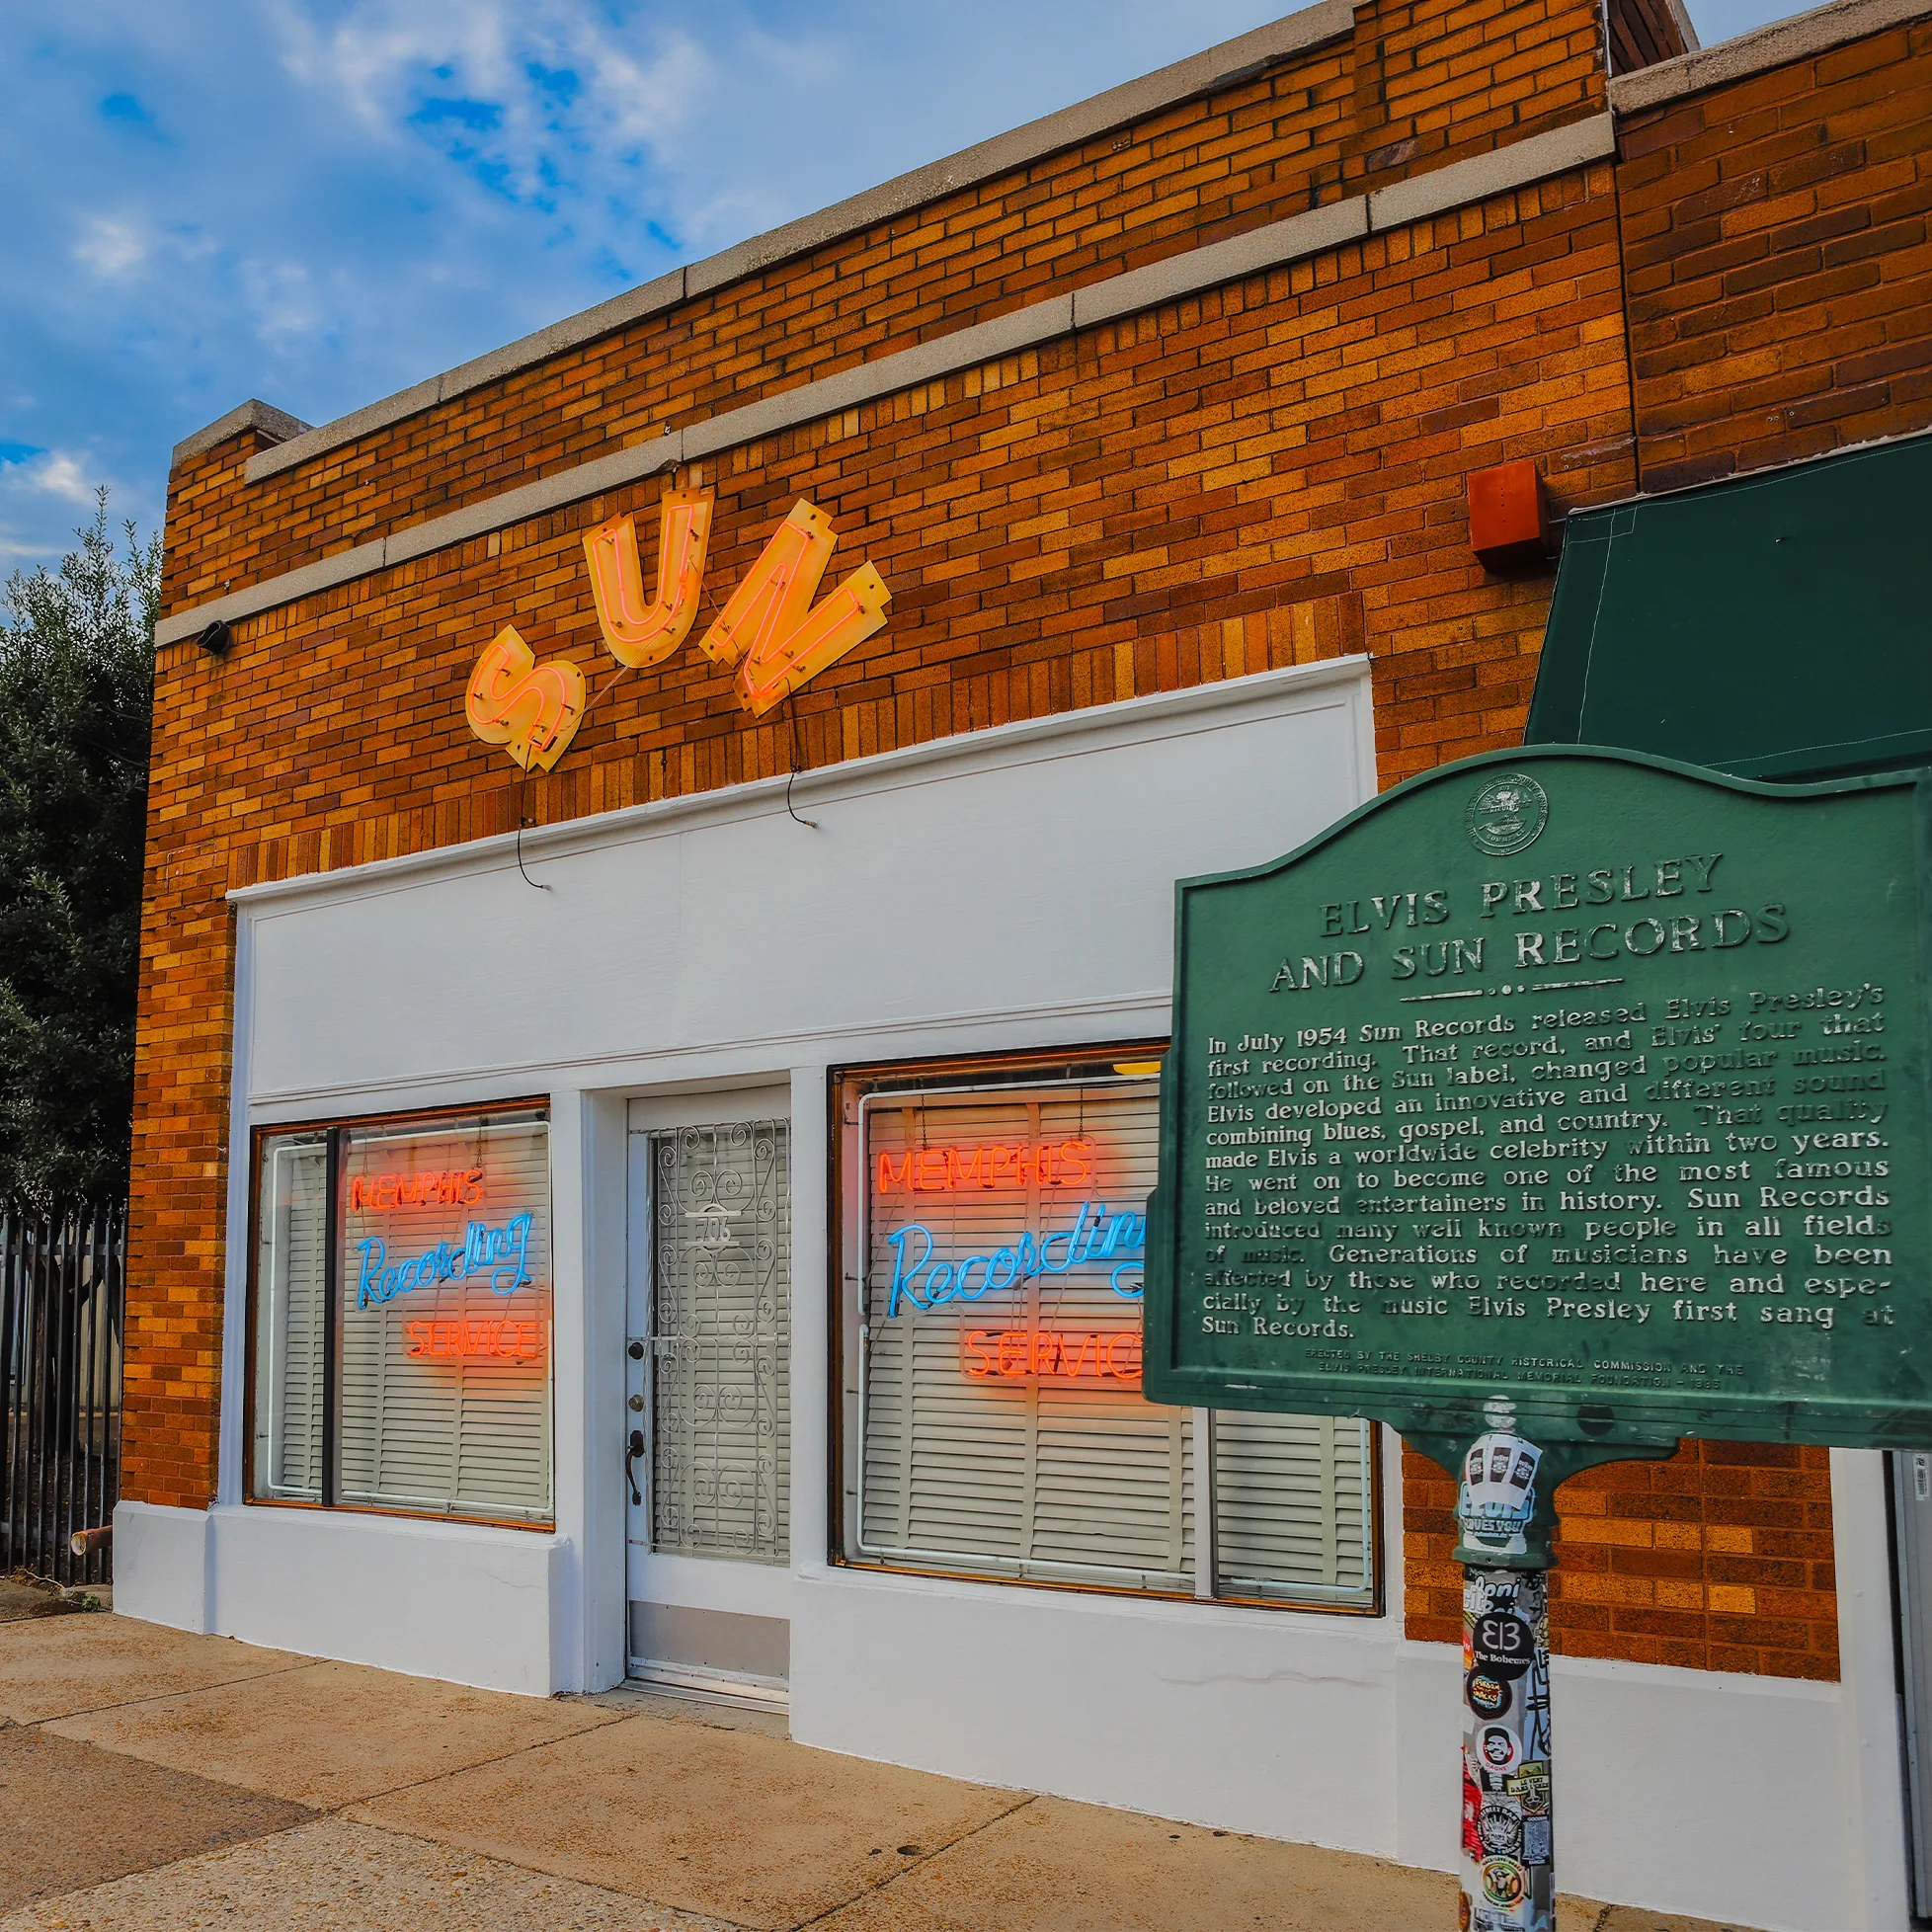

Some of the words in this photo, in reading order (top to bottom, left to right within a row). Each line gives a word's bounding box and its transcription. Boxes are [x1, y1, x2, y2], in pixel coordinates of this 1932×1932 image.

[465, 488, 892, 772] SUN
[1319, 889, 1450, 937] ELVIS
[1479, 852, 1724, 919] PRESLEY
[1269, 951, 1365, 993] AND
[1391, 936, 1486, 981] SUN
[1514, 903, 1791, 970] RECORDS
[1208, 1037, 1227, 1054] In
[1238, 1033, 1284, 1053] July
[1297, 1027, 1347, 1047] 1954
[1359, 1024, 1402, 1042] Sun
[1415, 1014, 1514, 1038] Records
[1531, 1002, 1648, 1030] released
[1664, 997, 1731, 1020] Elvis
[1748, 983, 1884, 1013] Presley's
[1208, 1059, 1249, 1077] first
[1261, 1053, 1378, 1074] recording.
[1403, 1044, 1458, 1064] That
[1472, 1035, 1567, 1060] record,
[1585, 1030, 1632, 1053] and
[1739, 1020, 1802, 1042] four
[1820, 1011, 1884, 1036] that
[1208, 1078, 1293, 1100] followed
[1303, 1079, 1329, 1094] on
[1343, 1074, 1381, 1091] the
[1392, 1070, 1434, 1087] Sun
[1446, 1064, 1515, 1085] label,
[1531, 1056, 1648, 1082] changed
[1663, 1049, 1777, 1077] popular
[1794, 1040, 1887, 1065] music.
[1208, 1105, 1254, 1123] Elvis
[1265, 1097, 1381, 1119] developed
[1395, 1100, 1422, 1114] an
[1435, 1088, 1566, 1112] innovative
[1578, 1084, 1628, 1104] and
[1643, 1079, 1776, 1100] different
[1794, 1069, 1887, 1093] sound
[1206, 1126, 1312, 1148] combining
[1324, 1123, 1386, 1142] blues,
[1399, 1117, 1485, 1143] gospel,
[1499, 1114, 1544, 1133] and
[1558, 1109, 1668, 1132] country.
[1695, 1103, 1762, 1126] That
[1777, 1098, 1889, 1126] quality
[879, 1141, 1088, 1193] MEMPHIS
[1205, 1152, 1257, 1168] made
[1267, 1149, 1318, 1167] Elvis
[1328, 1152, 1341, 1166] a
[1354, 1143, 1478, 1165] worldwide
[1489, 1137, 1608, 1161] celebrity
[1628, 1132, 1711, 1155] within
[1726, 1133, 1778, 1152] two
[1791, 1130, 1890, 1155] years.
[352, 1168, 483, 1211] MEMPHIS
[1205, 1175, 1232, 1192] He
[1248, 1173, 1297, 1191] went
[1314, 1174, 1341, 1190] on
[1357, 1171, 1380, 1188] to
[1394, 1169, 1485, 1187] become
[1502, 1168, 1549, 1186] one
[1567, 1164, 1594, 1183] of
[1613, 1164, 1657, 1182] the
[1679, 1160, 1751, 1181] most
[1774, 1158, 1890, 1179] famous
[1205, 1198, 1242, 1216] and
[1254, 1196, 1340, 1215] beloved
[1356, 1193, 1506, 1215] entertainers
[1521, 1191, 1545, 1211] in
[1560, 1191, 1662, 1213] history.
[1687, 1188, 1740, 1209] Sun
[1759, 1185, 1890, 1209] Records
[1205, 1221, 1322, 1239] introduced
[1335, 1223, 1399, 1242] many
[1412, 1219, 1462, 1238] well
[1478, 1217, 1565, 1238] known
[1585, 1217, 1676, 1242] people
[1697, 1217, 1724, 1237] in
[1744, 1216, 1781, 1237] all
[1803, 1215, 1892, 1236] fields
[357, 1212, 532, 1310] Recording
[1205, 1245, 1225, 1263] of
[1242, 1246, 1305, 1263] music.
[1328, 1245, 1478, 1263] Generations
[1499, 1244, 1528, 1263] of
[1551, 1244, 1688, 1265] musicians
[1714, 1245, 1788, 1265] have
[1814, 1244, 1892, 1265] been
[1205, 1270, 1291, 1287] affected
[1305, 1269, 1333, 1291] by
[1348, 1271, 1415, 1289] those
[1431, 1271, 1480, 1289] who
[1496, 1271, 1621, 1291] recorded
[1641, 1272, 1707, 1292] here
[1730, 1273, 1784, 1294] and
[1805, 1279, 1891, 1300] espe-
[1202, 1317, 1239, 1334] Sun
[1253, 1318, 1355, 1338] Records.
[1203, 1293, 1261, 1315] cially
[1277, 1294, 1305, 1316] by
[1323, 1295, 1361, 1313] the
[1382, 1297, 1448, 1315] music
[1468, 1297, 1526, 1317] Elvis
[1547, 1297, 1651, 1324] Presley
[1672, 1300, 1737, 1322] first
[1759, 1304, 1834, 1329] sang
[1862, 1305, 1895, 1326] at
[409, 1321, 537, 1357] SERVICE
[967, 1329, 1144, 1379] SERVIC
[1305, 1348, 1350, 1359] ERECTED
[1357, 1350, 1372, 1360] BY
[1379, 1351, 1400, 1361] THE
[1408, 1353, 1450, 1364] SHELBY
[1457, 1355, 1503, 1366] COUNTY
[1511, 1355, 1584, 1370] HISTORICAL
[1594, 1359, 1671, 1373] COMMISSION
[1679, 1363, 1706, 1374] AND
[1716, 1364, 1743, 1376] THE
[1319, 1362, 1350, 1372] ELVIS
[1358, 1364, 1407, 1376] PRESLEY
[1414, 1367, 1509, 1380] INTERNATIONAL
[1517, 1371, 1581, 1383] MEMORIAL
[1591, 1373, 1670, 1388] FOUNDATION
[1475, 1650, 1489, 1661] The
[1489, 1653, 1530, 1665] Bohemes
